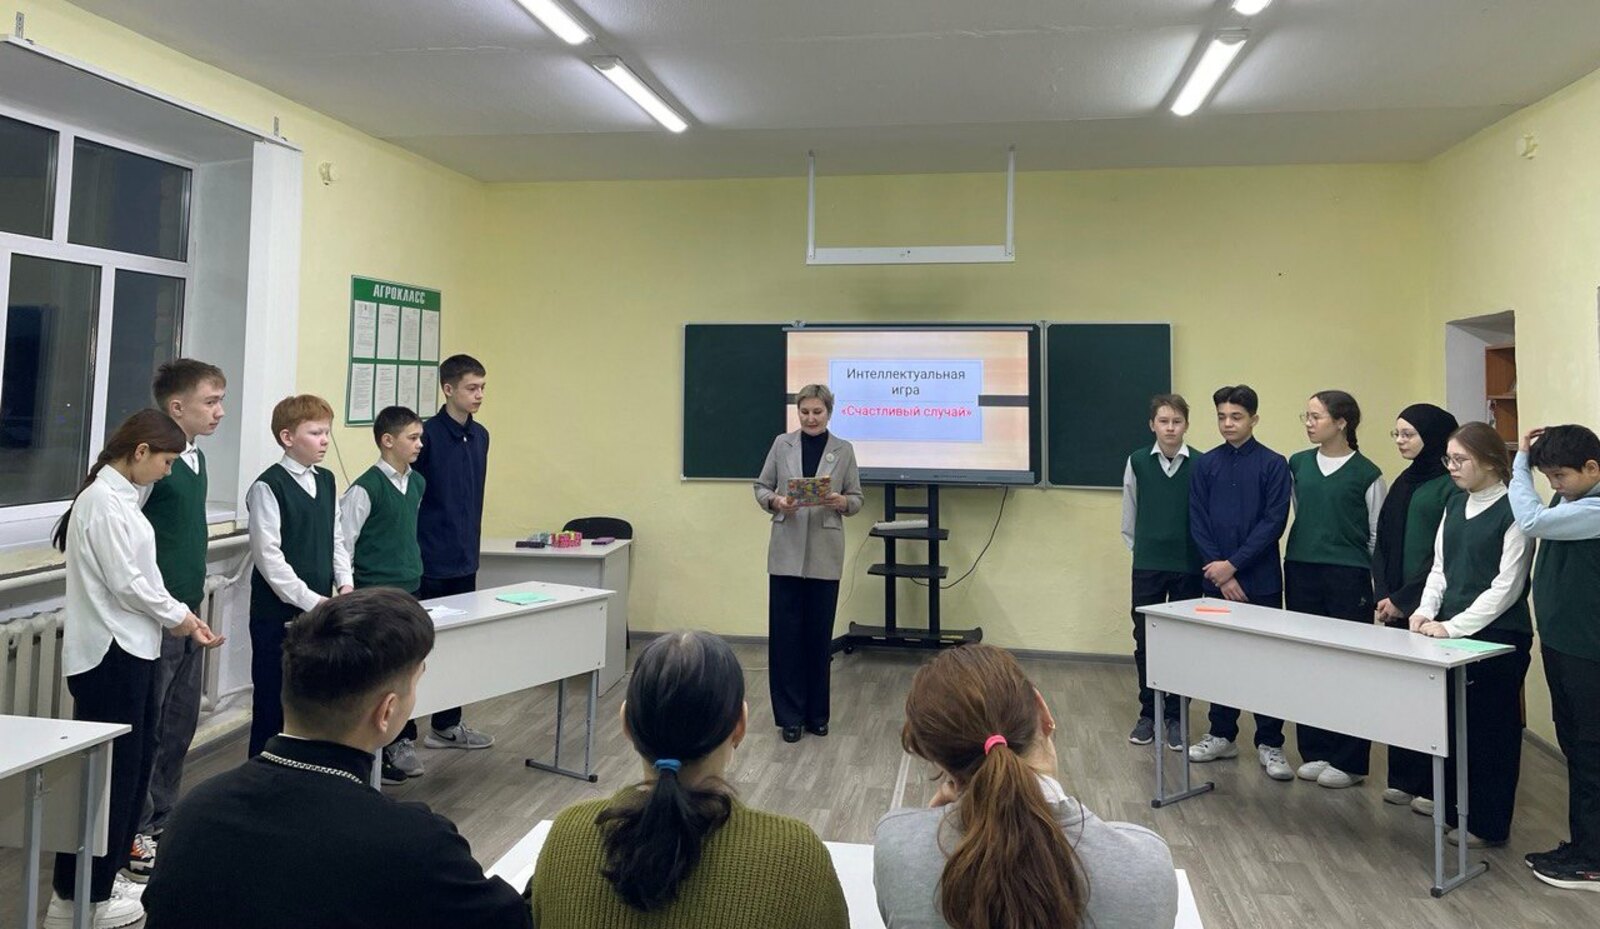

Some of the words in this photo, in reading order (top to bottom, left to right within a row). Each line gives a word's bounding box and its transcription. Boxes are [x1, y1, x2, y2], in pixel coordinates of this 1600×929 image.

[373, 284, 425, 304] АГРОКЛАСС
[846, 368, 966, 382] Интеллектуальная
[891, 386, 920, 397] игра
[841, 404, 921, 417] «Счастливый
[923, 406, 972, 420] случай»
